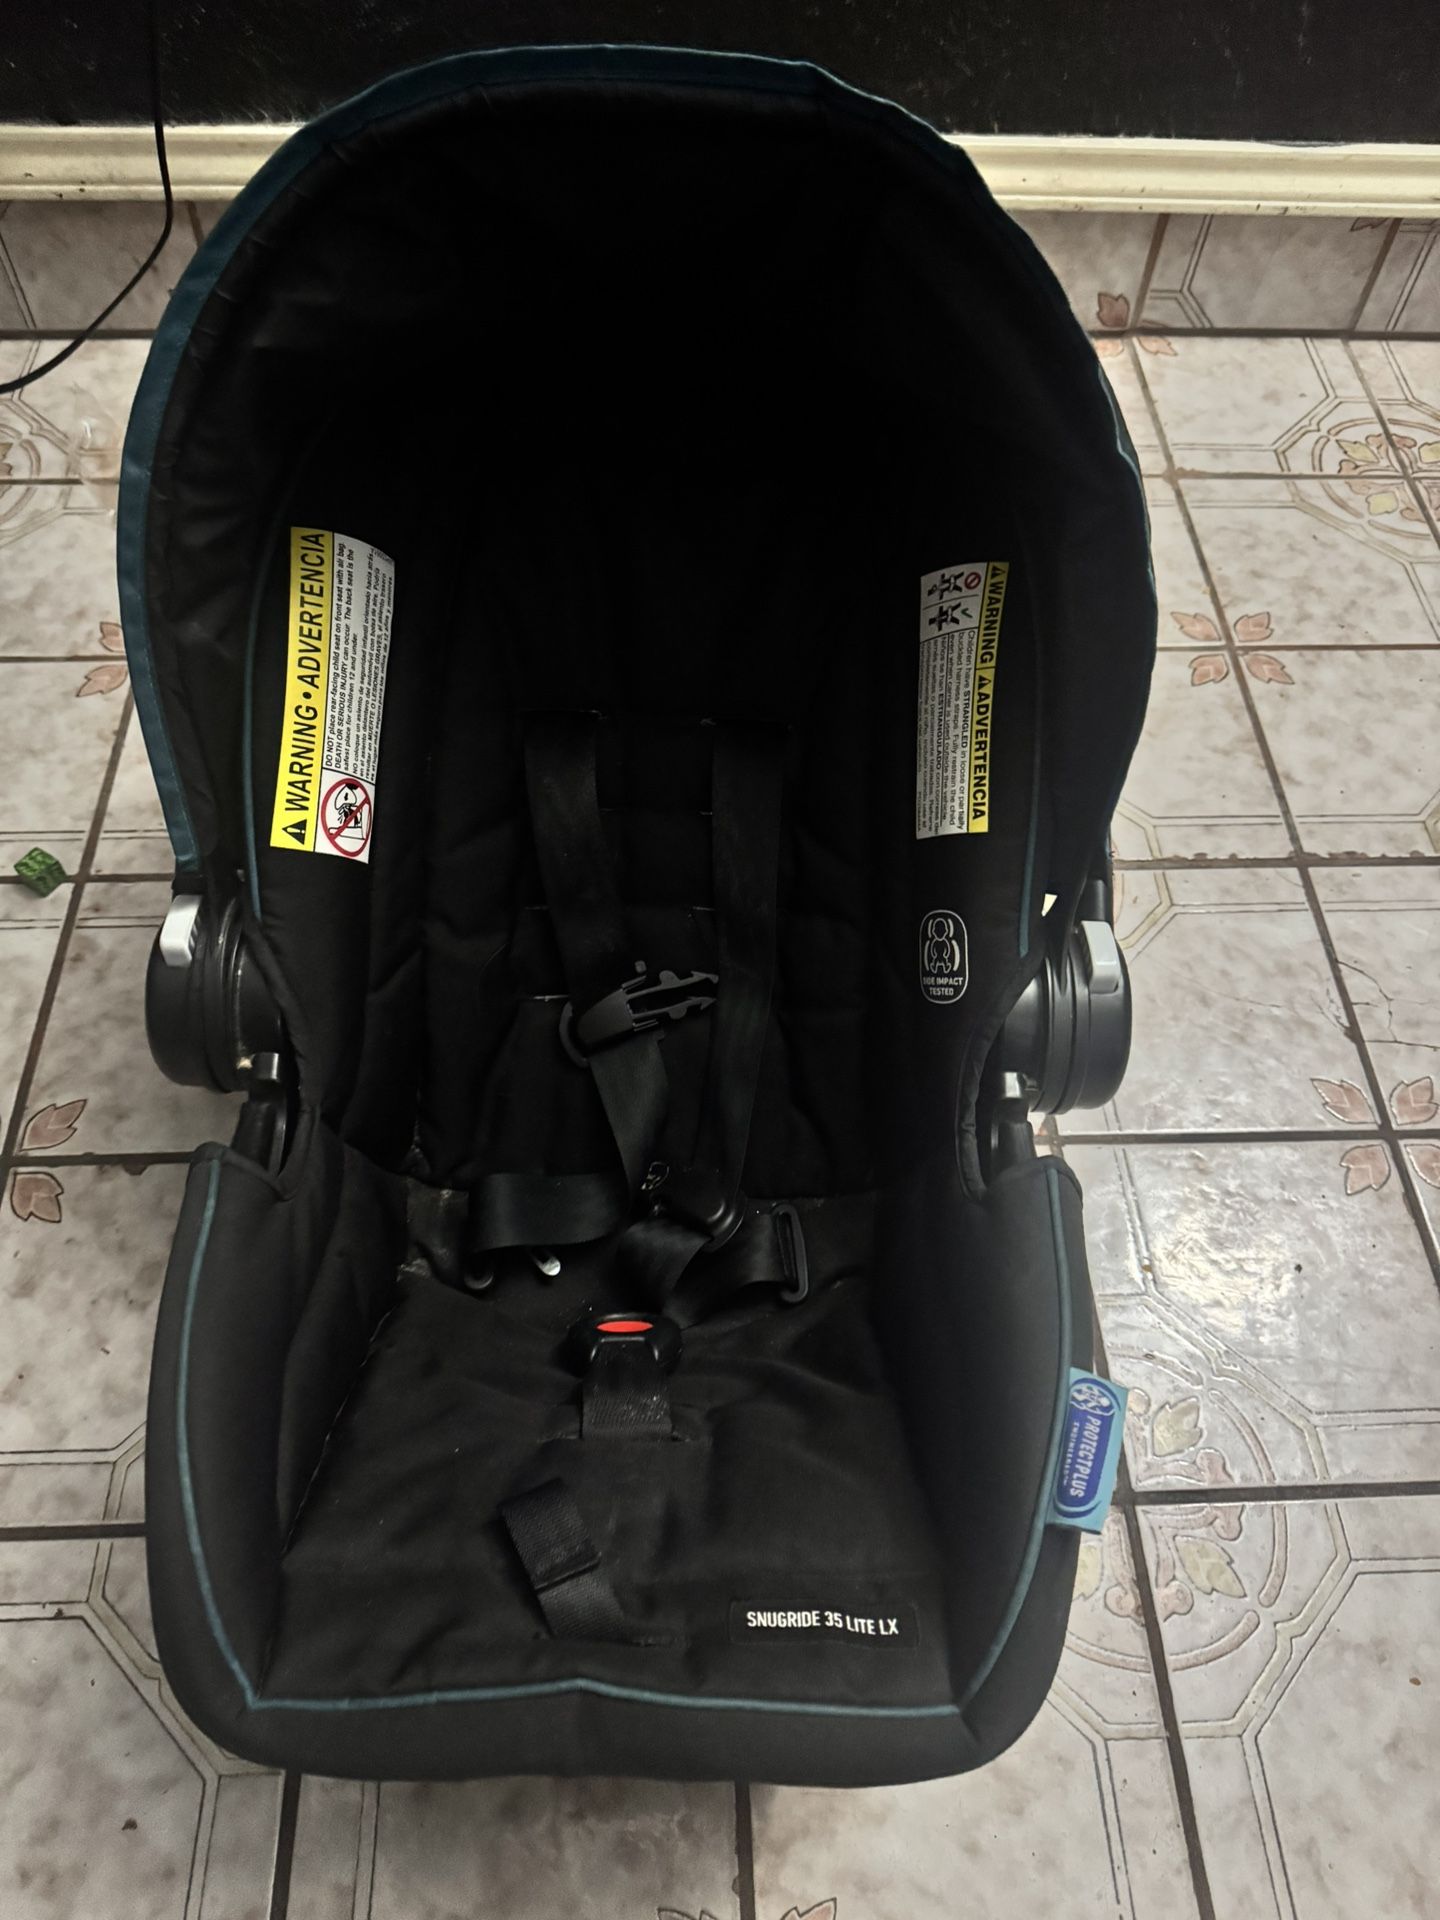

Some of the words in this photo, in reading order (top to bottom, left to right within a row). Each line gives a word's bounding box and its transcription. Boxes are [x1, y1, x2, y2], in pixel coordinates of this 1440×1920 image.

[297, 533, 324, 689] ADVERTENCIA
[336, 624, 341, 633] on
[980, 581, 1004, 664] WARNING
[966, 631, 975, 666] Children
[331, 672, 339, 713] rear-facing
[349, 672, 355, 680] 12
[964, 668, 972, 688] have
[337, 729, 343, 740] OR
[340, 662, 348, 690] INJURY
[353, 763, 358, 774] NO
[356, 723, 360, 732] un
[358, 686, 363, 695] de
[936, 694, 944, 770] ESTRANGULADO
[961, 691, 970, 748] STRANGLED
[285, 705, 318, 812] WARNING
[325, 755, 332, 766] DO
[326, 736, 334, 753] NOT
[972, 692, 990, 820] ADVERTENCIA
[360, 768, 364, 777] en
[959, 786, 965, 794] or
[957, 797, 965, 829] partially
[937, 977, 963, 985] IMPACT
[1070, 1416, 1101, 1497] PROTECTPLUS
[747, 1611, 820, 1627] SNUGRIDE
[825, 1612, 843, 1628] 35
[845, 1615, 876, 1635] LITE
[879, 1619, 898, 1635] LX
